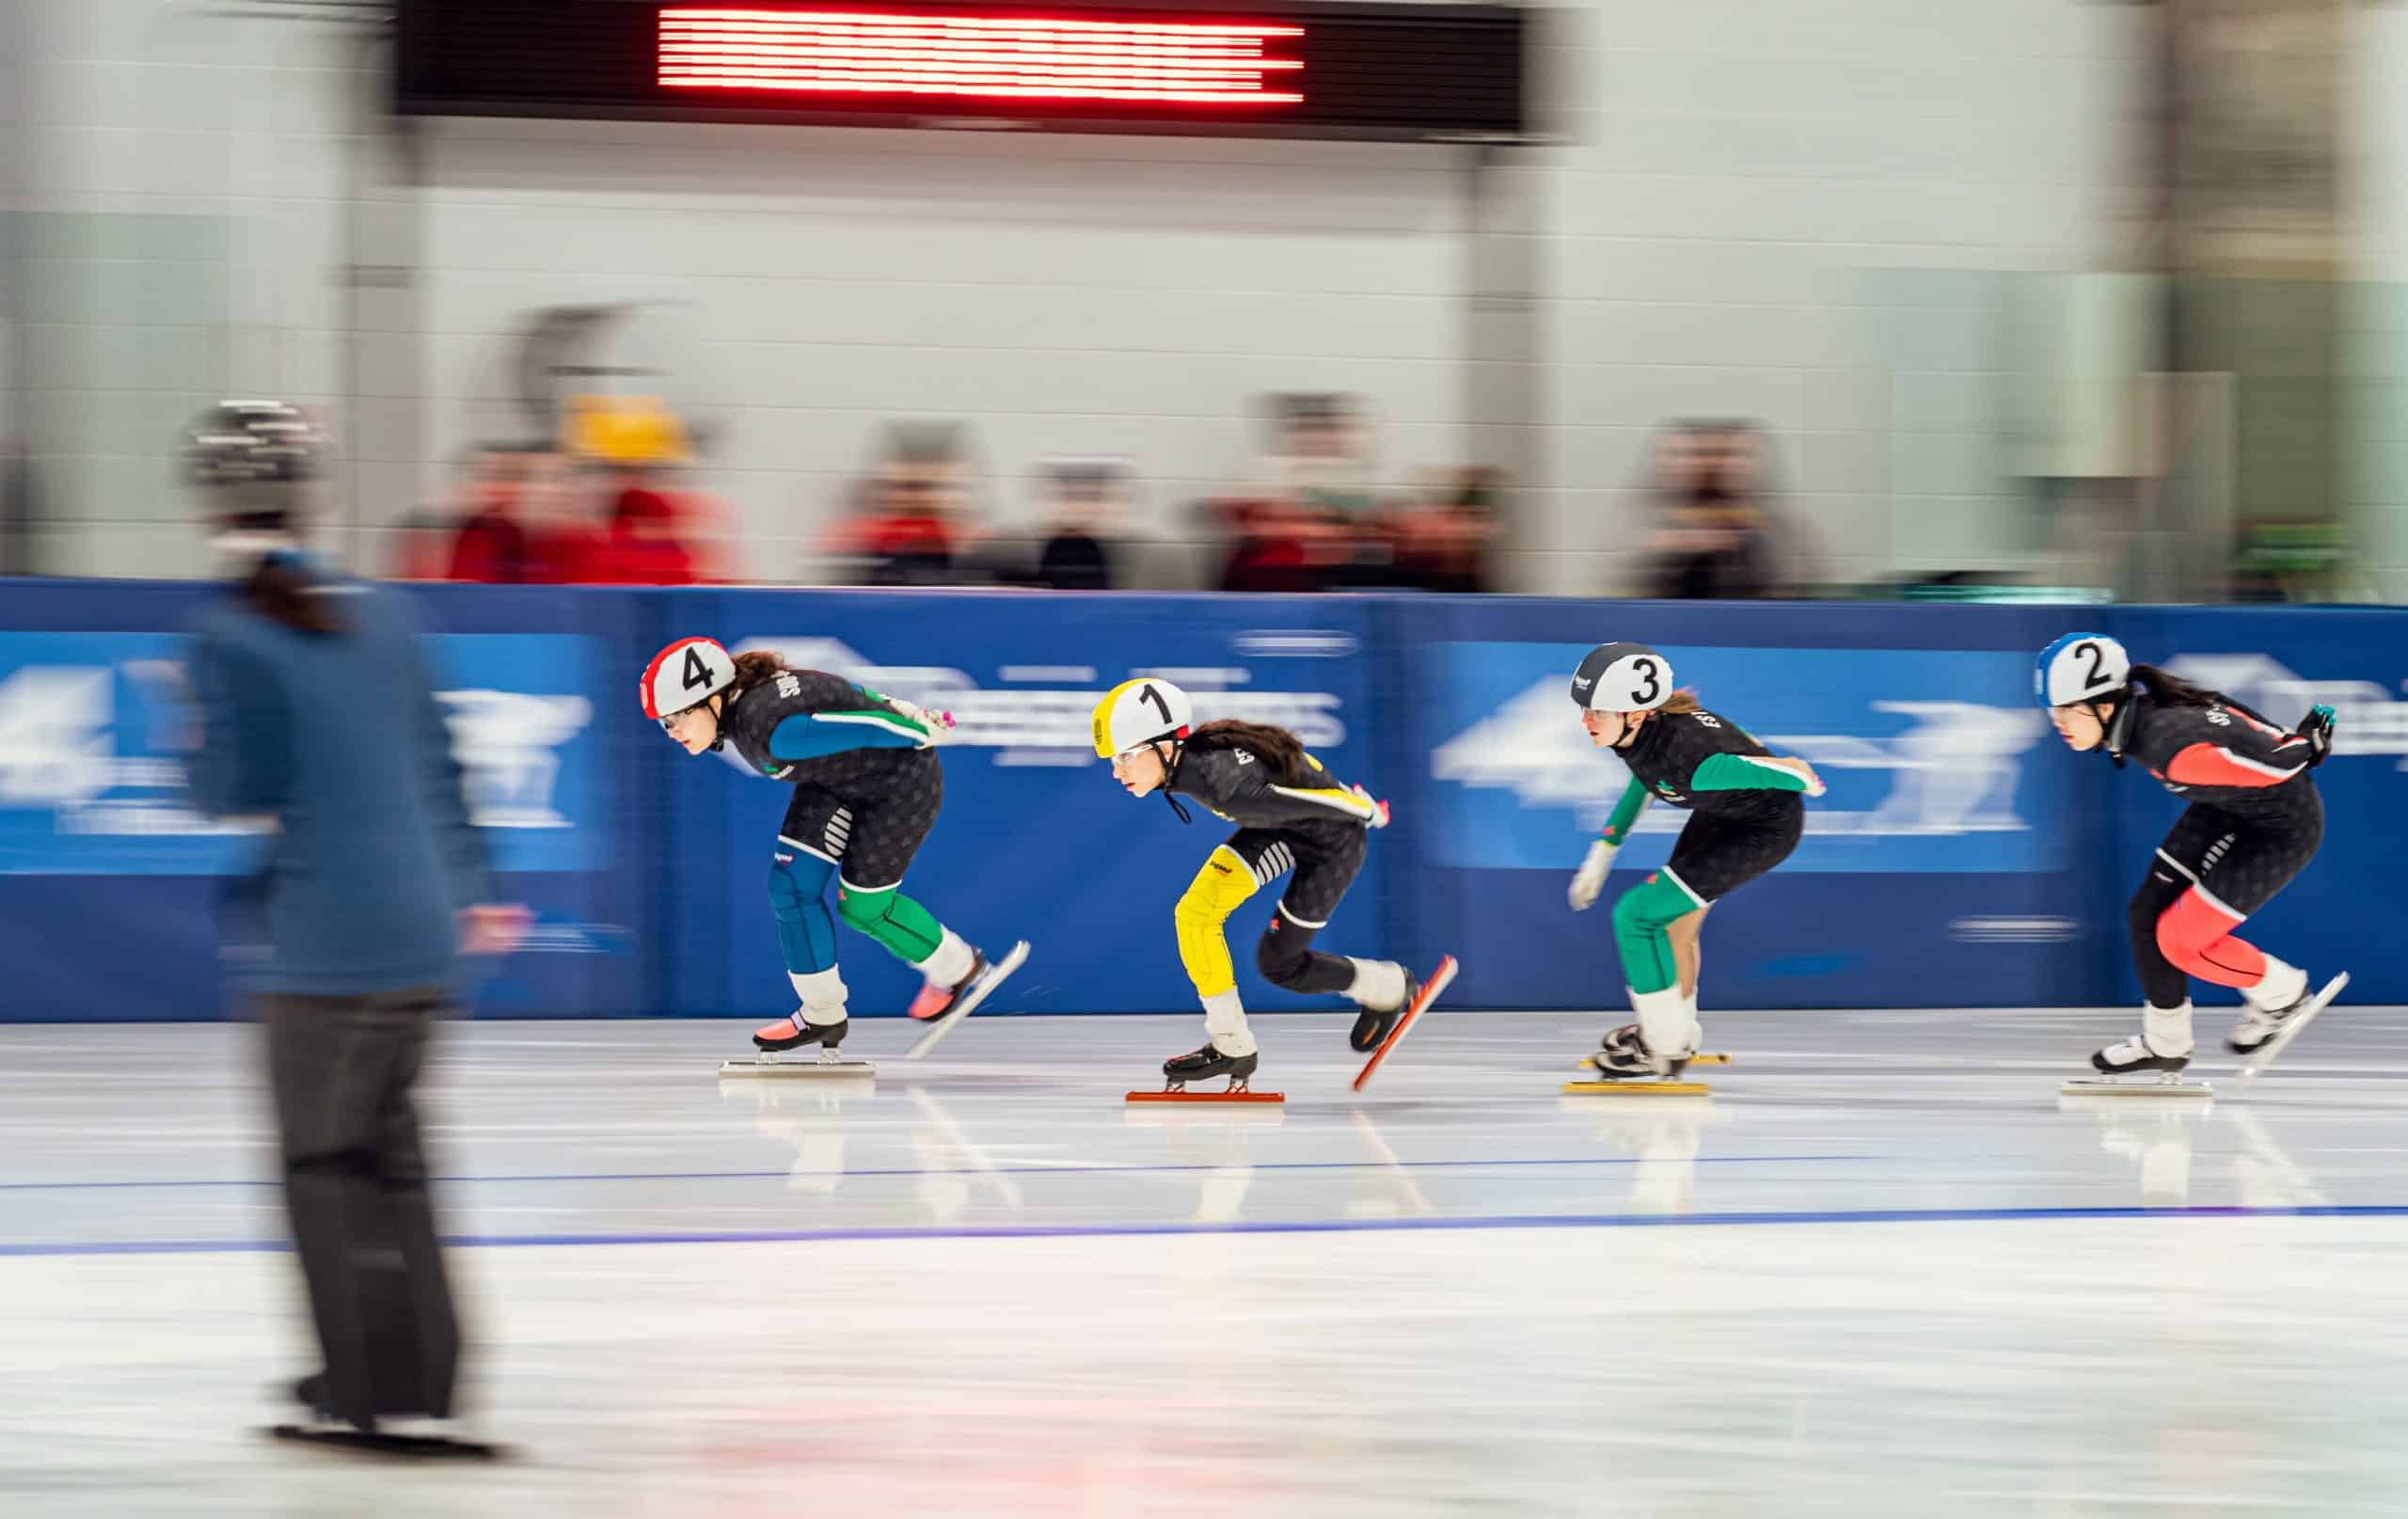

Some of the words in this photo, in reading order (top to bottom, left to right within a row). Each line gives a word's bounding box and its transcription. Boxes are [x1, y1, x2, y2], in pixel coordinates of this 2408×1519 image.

[682, 646, 715, 690] 4
[1631, 657, 1659, 704] 3
[2074, 641, 2112, 690] 2
[1139, 684, 1173, 725] 1
